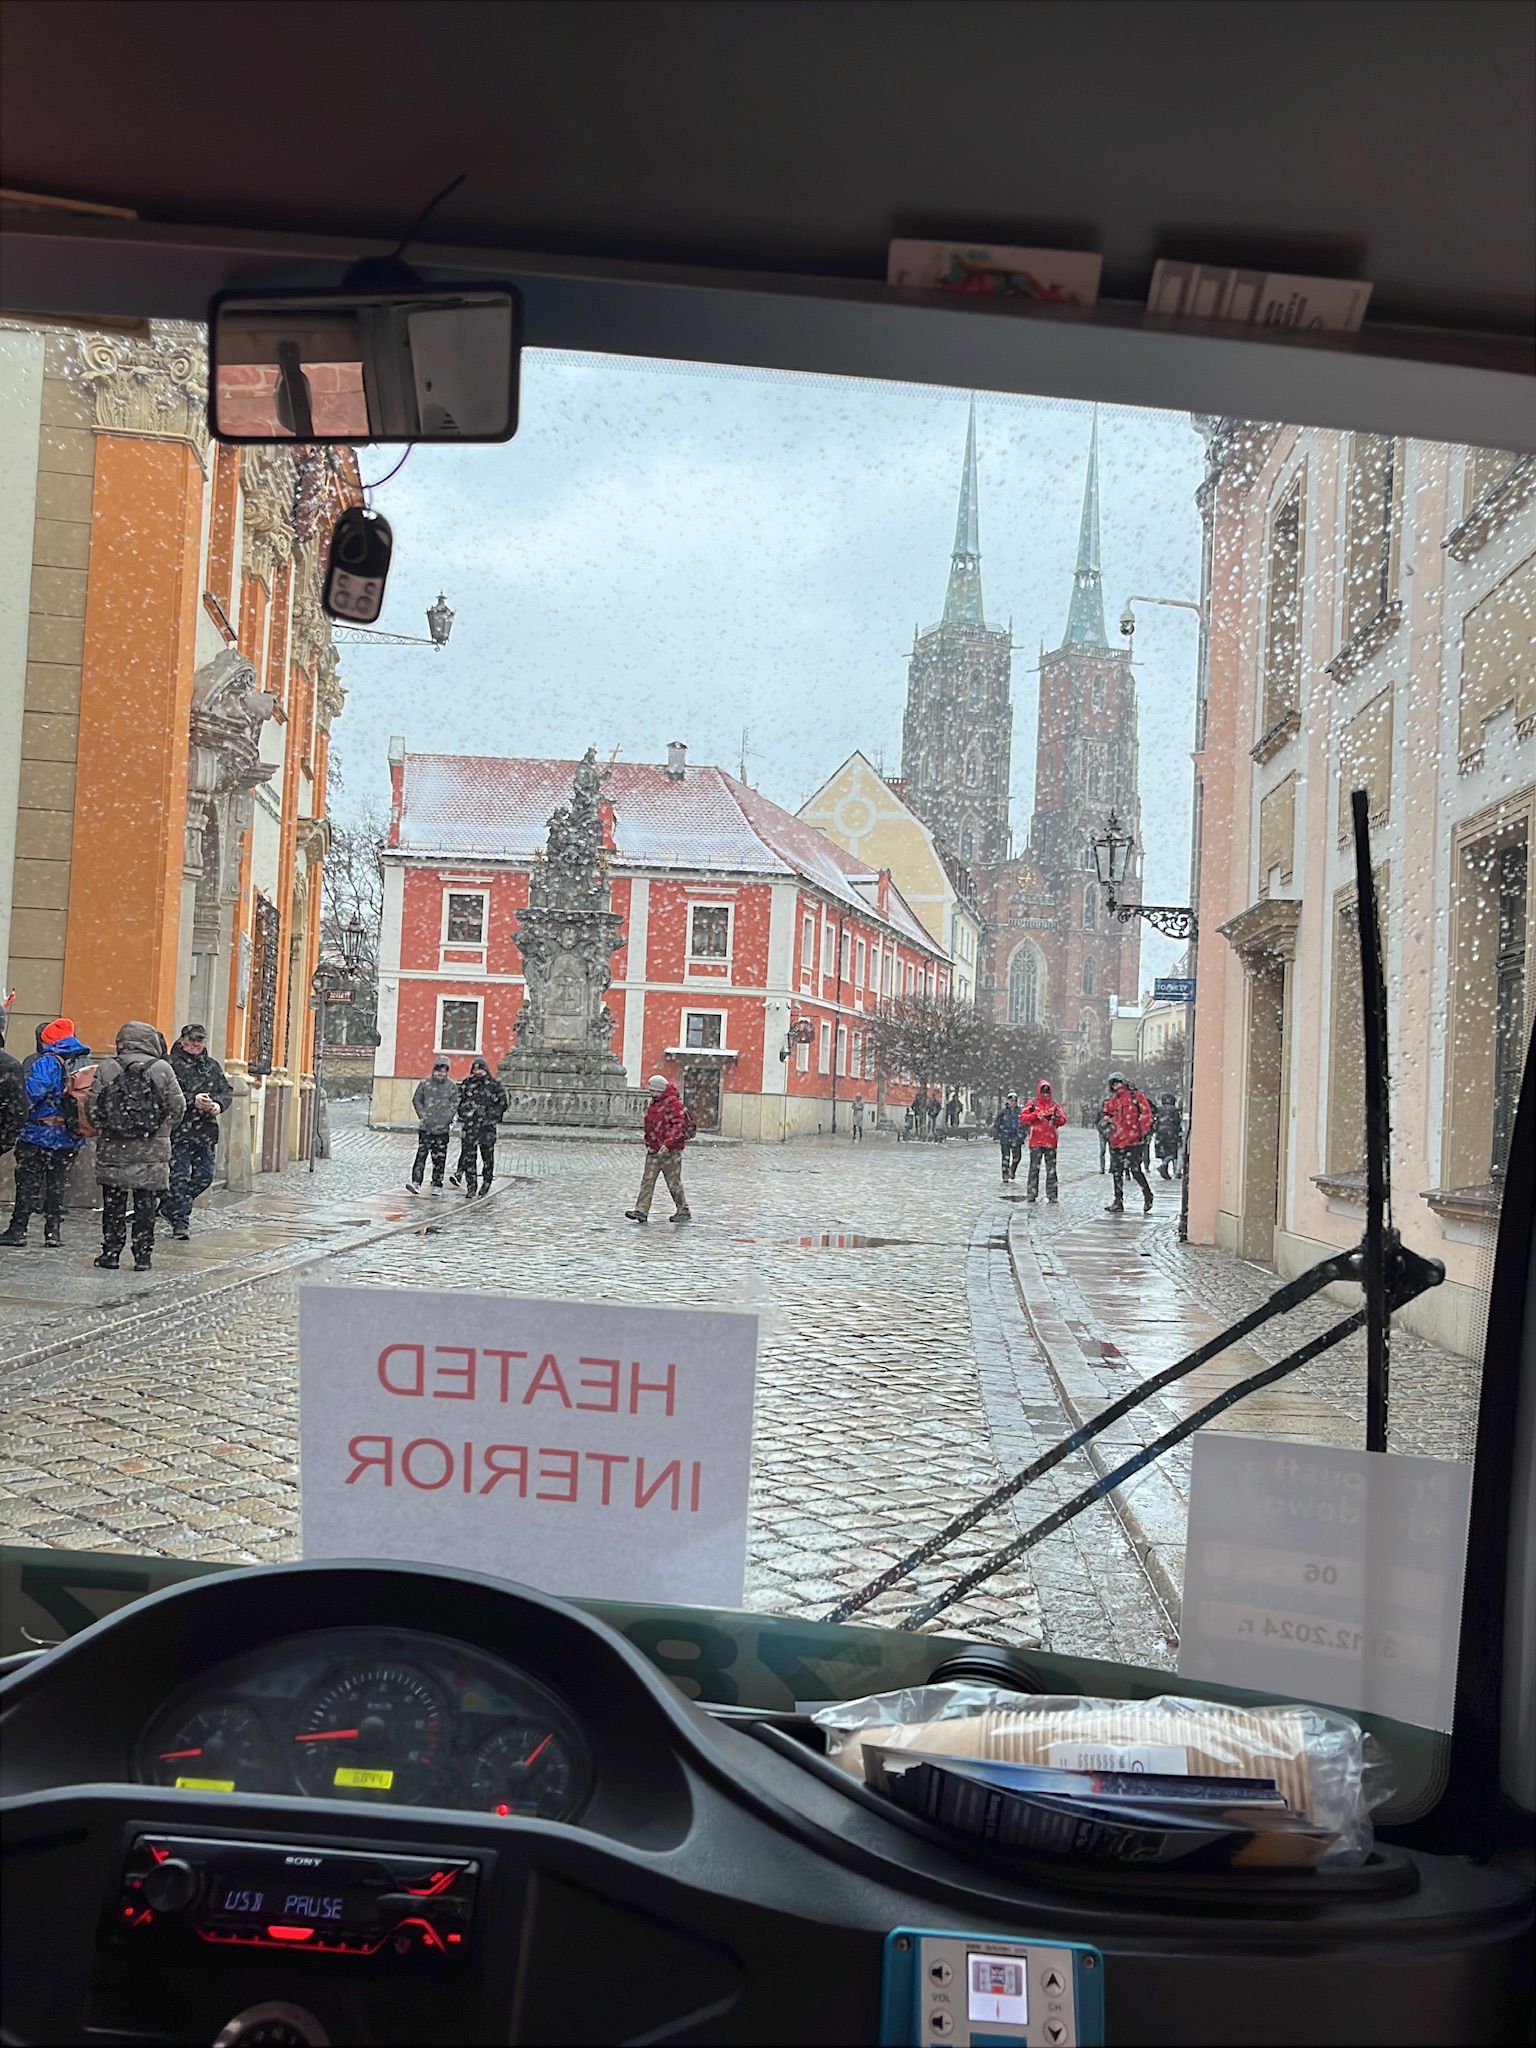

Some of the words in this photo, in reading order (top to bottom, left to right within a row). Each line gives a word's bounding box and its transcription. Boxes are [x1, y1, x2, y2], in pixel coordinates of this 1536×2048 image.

[284, 1856, 323, 1867] SONY
[224, 1890, 263, 1911] USB
[283, 1894, 344, 1919] PAUSE
